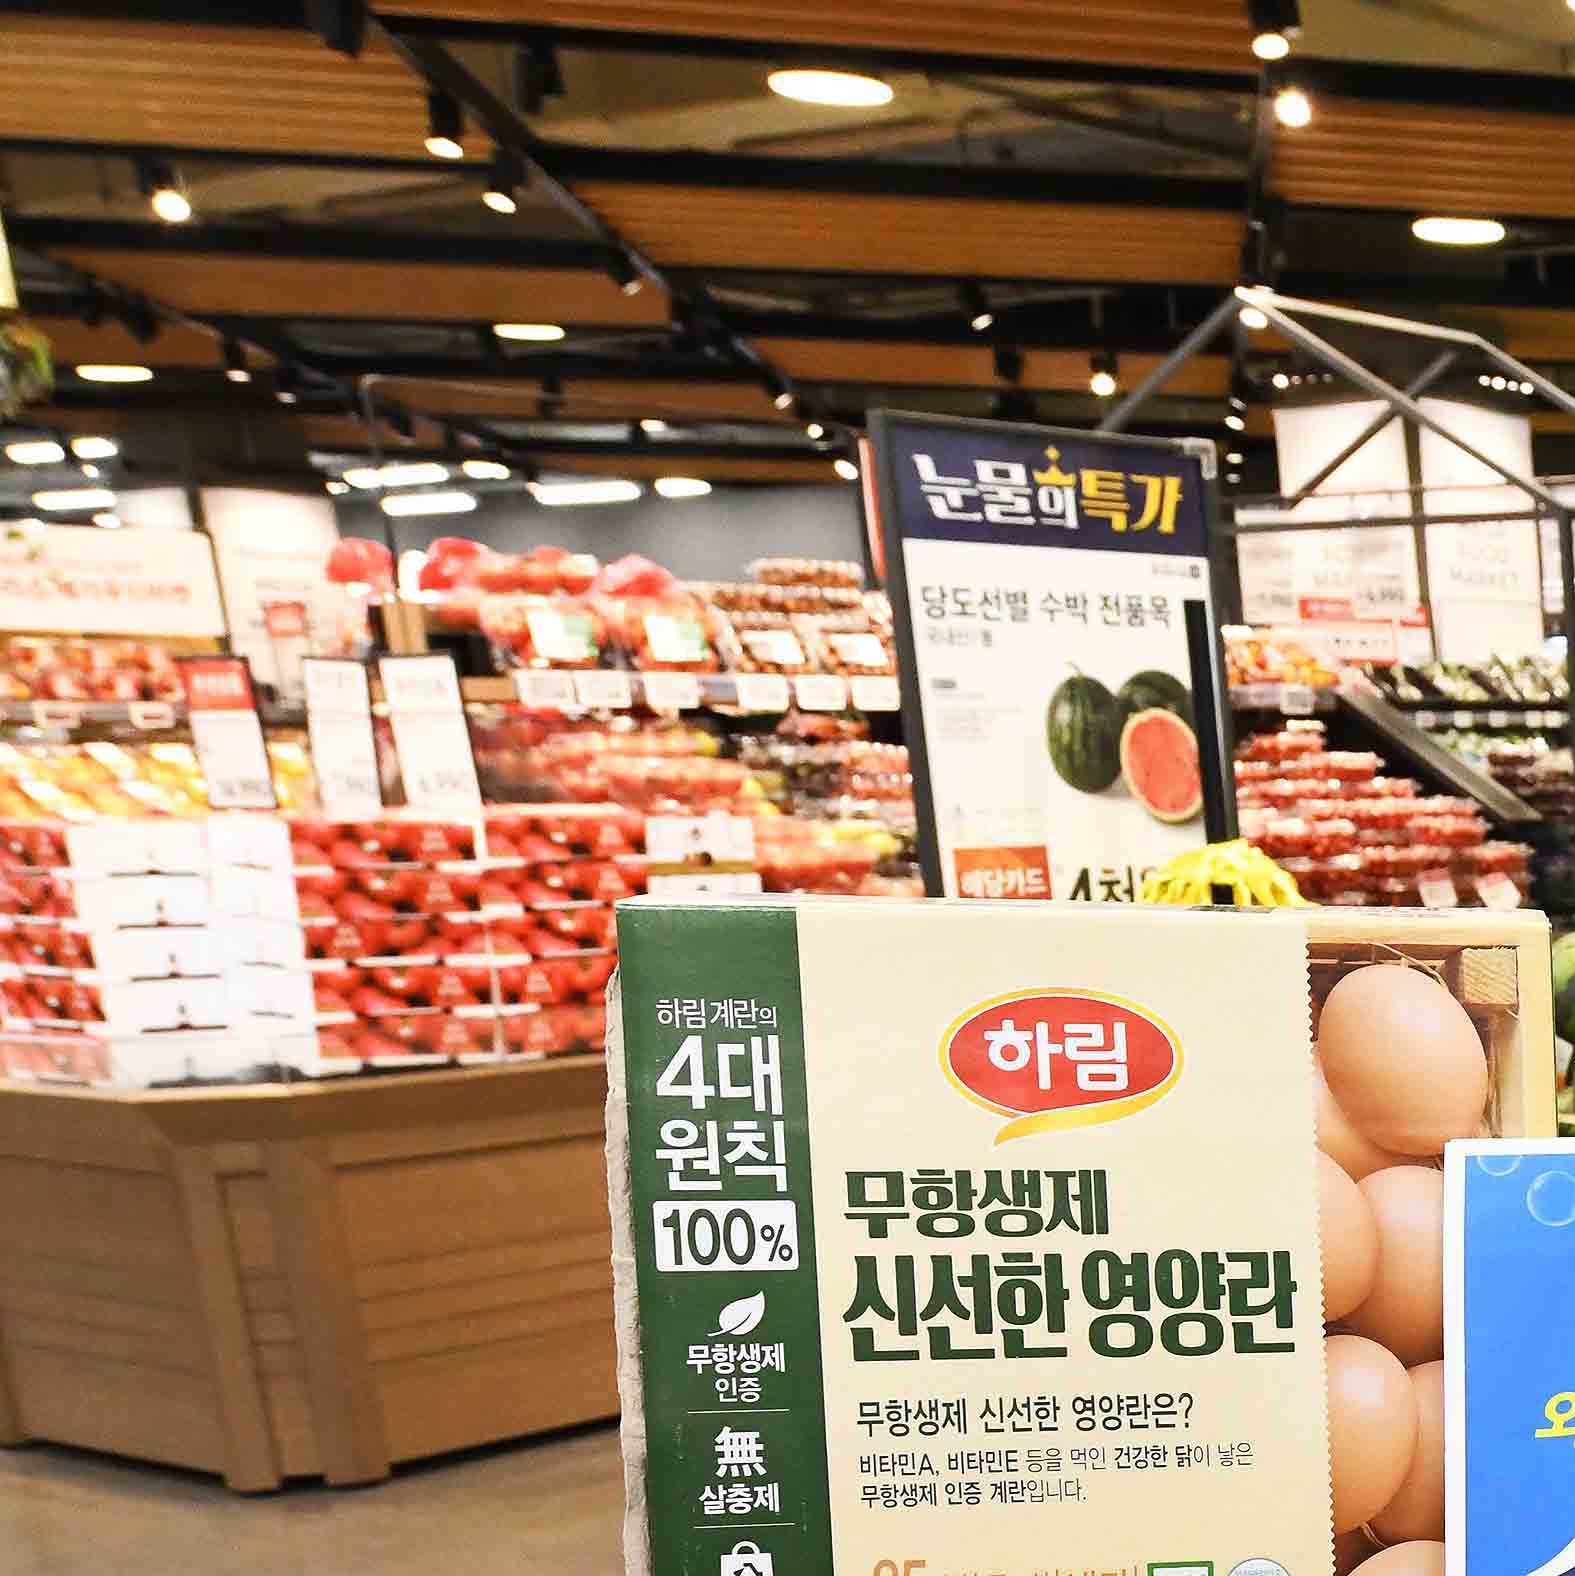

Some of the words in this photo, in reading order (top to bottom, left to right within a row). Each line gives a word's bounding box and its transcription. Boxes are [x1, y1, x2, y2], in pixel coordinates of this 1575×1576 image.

[1079, 468, 1183, 534] 특가
[920, 585, 1030, 623] 당도선별
[1040, 591, 1090, 625] 수박
[1098, 595, 1171, 630] 전품목
[656, 997, 706, 1029] 하림
[710, 998, 777, 1028] 계란의
[656, 1034, 783, 1116] 4대
[983, 1018, 1129, 1093] 하림
[655, 1119, 787, 1192] 원칙
[843, 1167, 1110, 1240] 무항생제
[662, 1208, 793, 1266] 100%
[841, 1253, 1070, 1363] 신선한
[1082, 1247, 1297, 1358] 영양란
[686, 1343, 787, 1374] 무항생제
[715, 1377, 762, 1403] 인증
[856, 1398, 968, 1438] 무항생제
[979, 1396, 1060, 1434] 신선한
[1071, 1392, 1194, 1432] 영양란은?
[714, 1426, 768, 1478] 無
[859, 1450, 940, 1478] 비타민A,
[947, 1448, 1019, 1474] 비타민E
[1025, 1447, 1062, 1473] 등을
[1070, 1446, 1106, 1471] 먹인
[1114, 1445, 1168, 1470] 건강한
[1175, 1444, 1210, 1469] 닭이
[1216, 1442, 1254, 1467] 낳은
[699, 1483, 780, 1515] 살충제
[860, 1481, 938, 1509] 무항생제
[944, 1480, 982, 1507] 인증
[990, 1478, 1087, 1505] 계란입니다.
